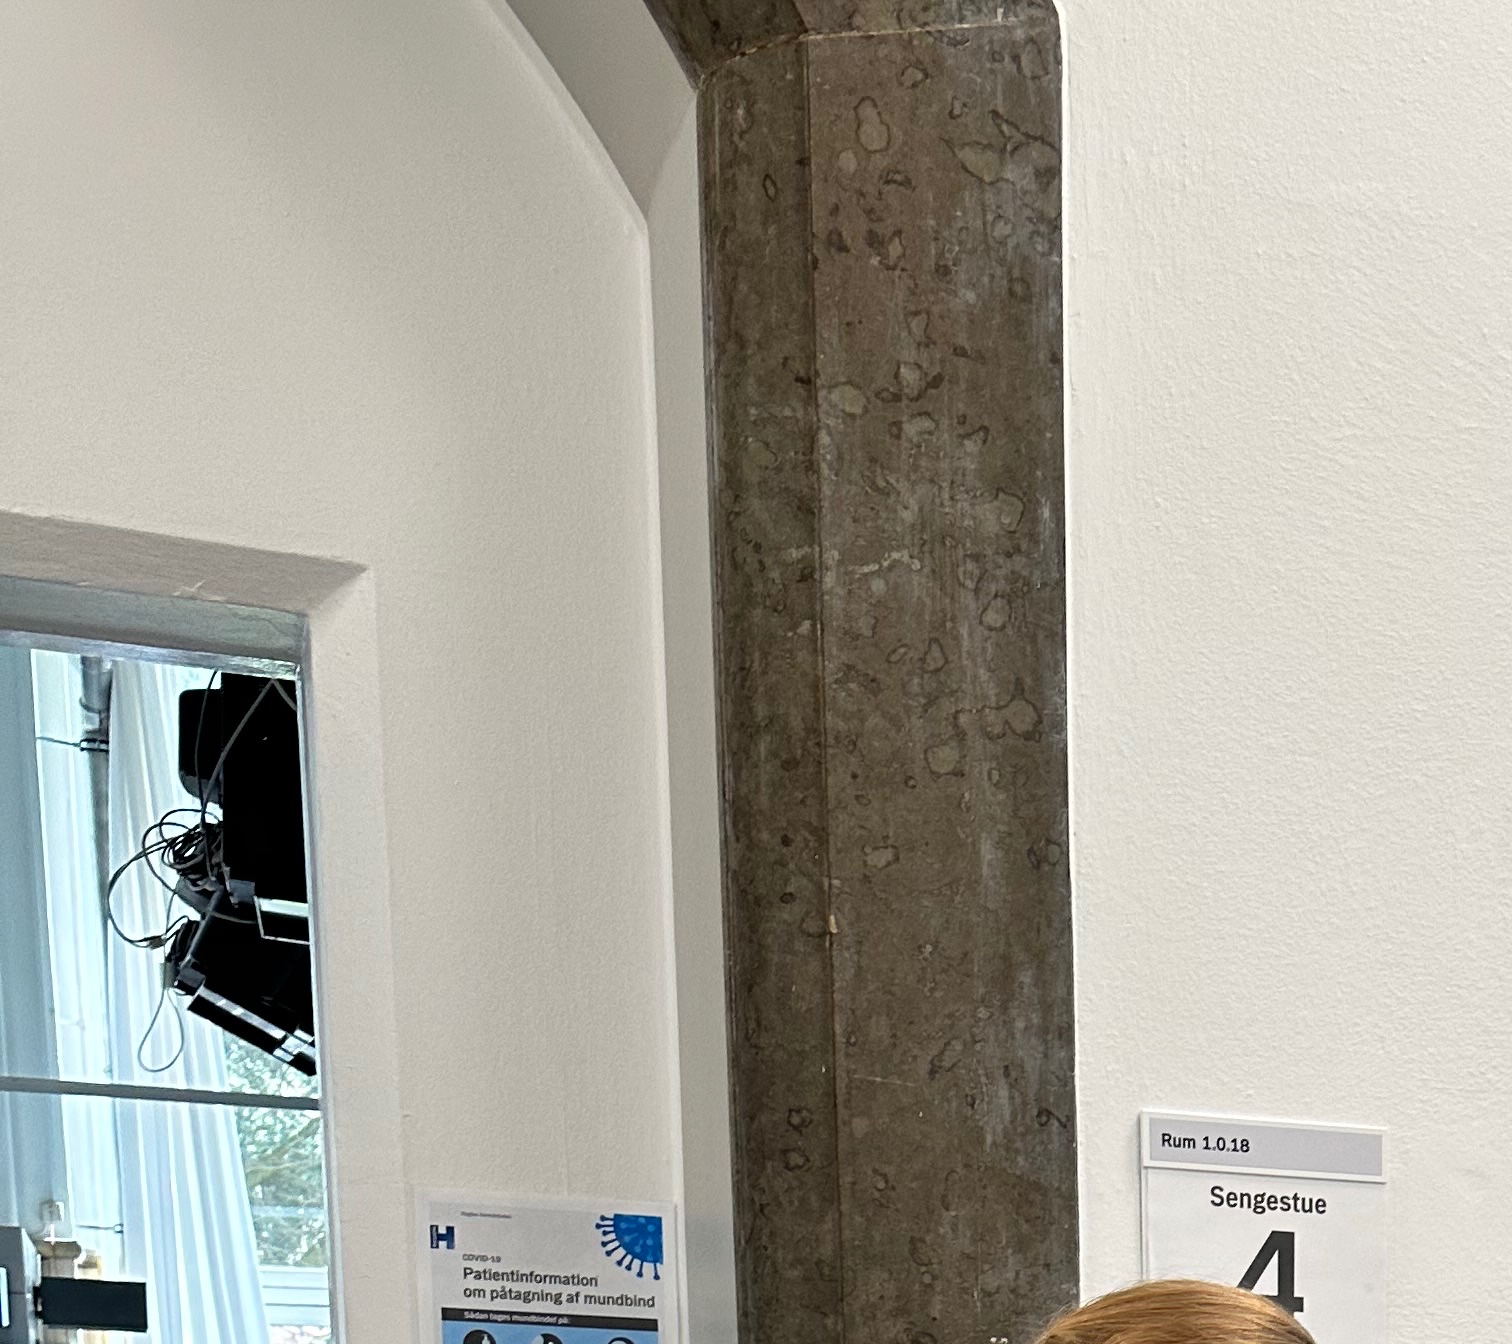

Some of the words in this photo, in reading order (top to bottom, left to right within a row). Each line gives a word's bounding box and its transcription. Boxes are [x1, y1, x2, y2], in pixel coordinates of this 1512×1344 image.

[1161, 1133, 1196, 1149] Rum
[1202, 1136, 1250, 1153] 1.0.18
[1210, 1186, 1327, 1214] Sengestue
[462, 1253, 502, 1263] COVID-19
[463, 1266, 599, 1288] Patientinformation
[1236, 1230, 1304, 1317] 4
[463, 1287, 486, 1299] om
[490, 1286, 563, 1305] påtagning
[566, 1291, 581, 1305] af
[584, 1293, 656, 1308] mundbind
